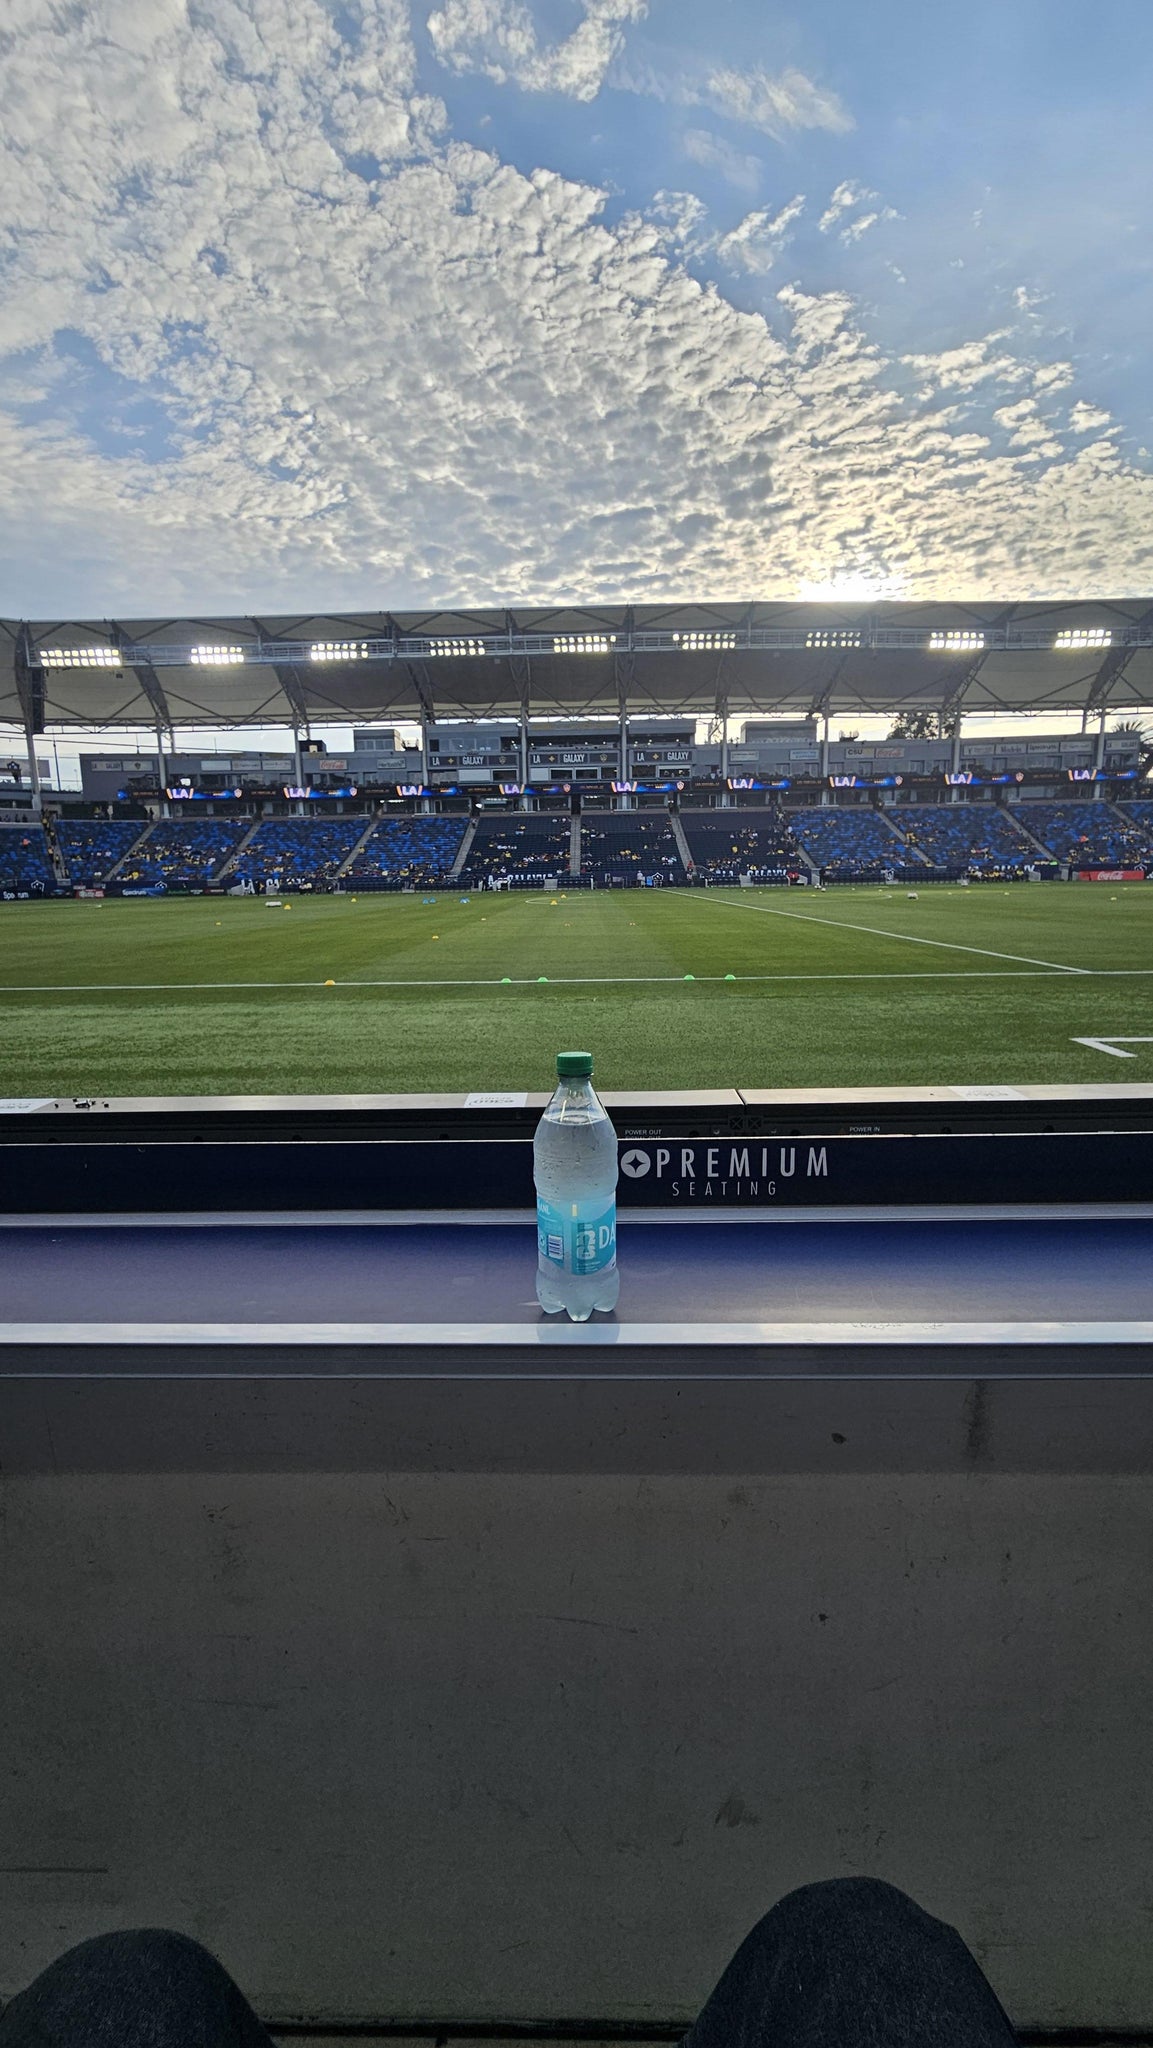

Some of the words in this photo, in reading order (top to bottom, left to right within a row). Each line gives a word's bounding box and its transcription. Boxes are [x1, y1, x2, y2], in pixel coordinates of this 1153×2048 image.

[432, 757, 440, 766] LA
[462, 756, 484, 765] GALAXY
[533, 755, 541, 764] LA
[563, 754, 585, 763] GALAXY
[637, 752, 645, 761] LA
[667, 752, 689, 761] GALAXY
[951, 774, 967, 784] LA
[1073, 770, 1090, 780] LA
[733, 778, 749, 789] LA
[834, 776, 850, 787] LA
[402, 785, 418, 796] LA
[504, 784, 520, 794] LA
[616, 782, 632, 792] LA
[172, 788, 189, 799] LA
[289, 787, 305, 798] LA
[1097, 871, 1124, 881] Coca-Cola
[3, 891, 29, 900] Sperum
[656, 1147, 828, 1178] PREMIUM
[672, 1181, 776, 1197] SEATING
